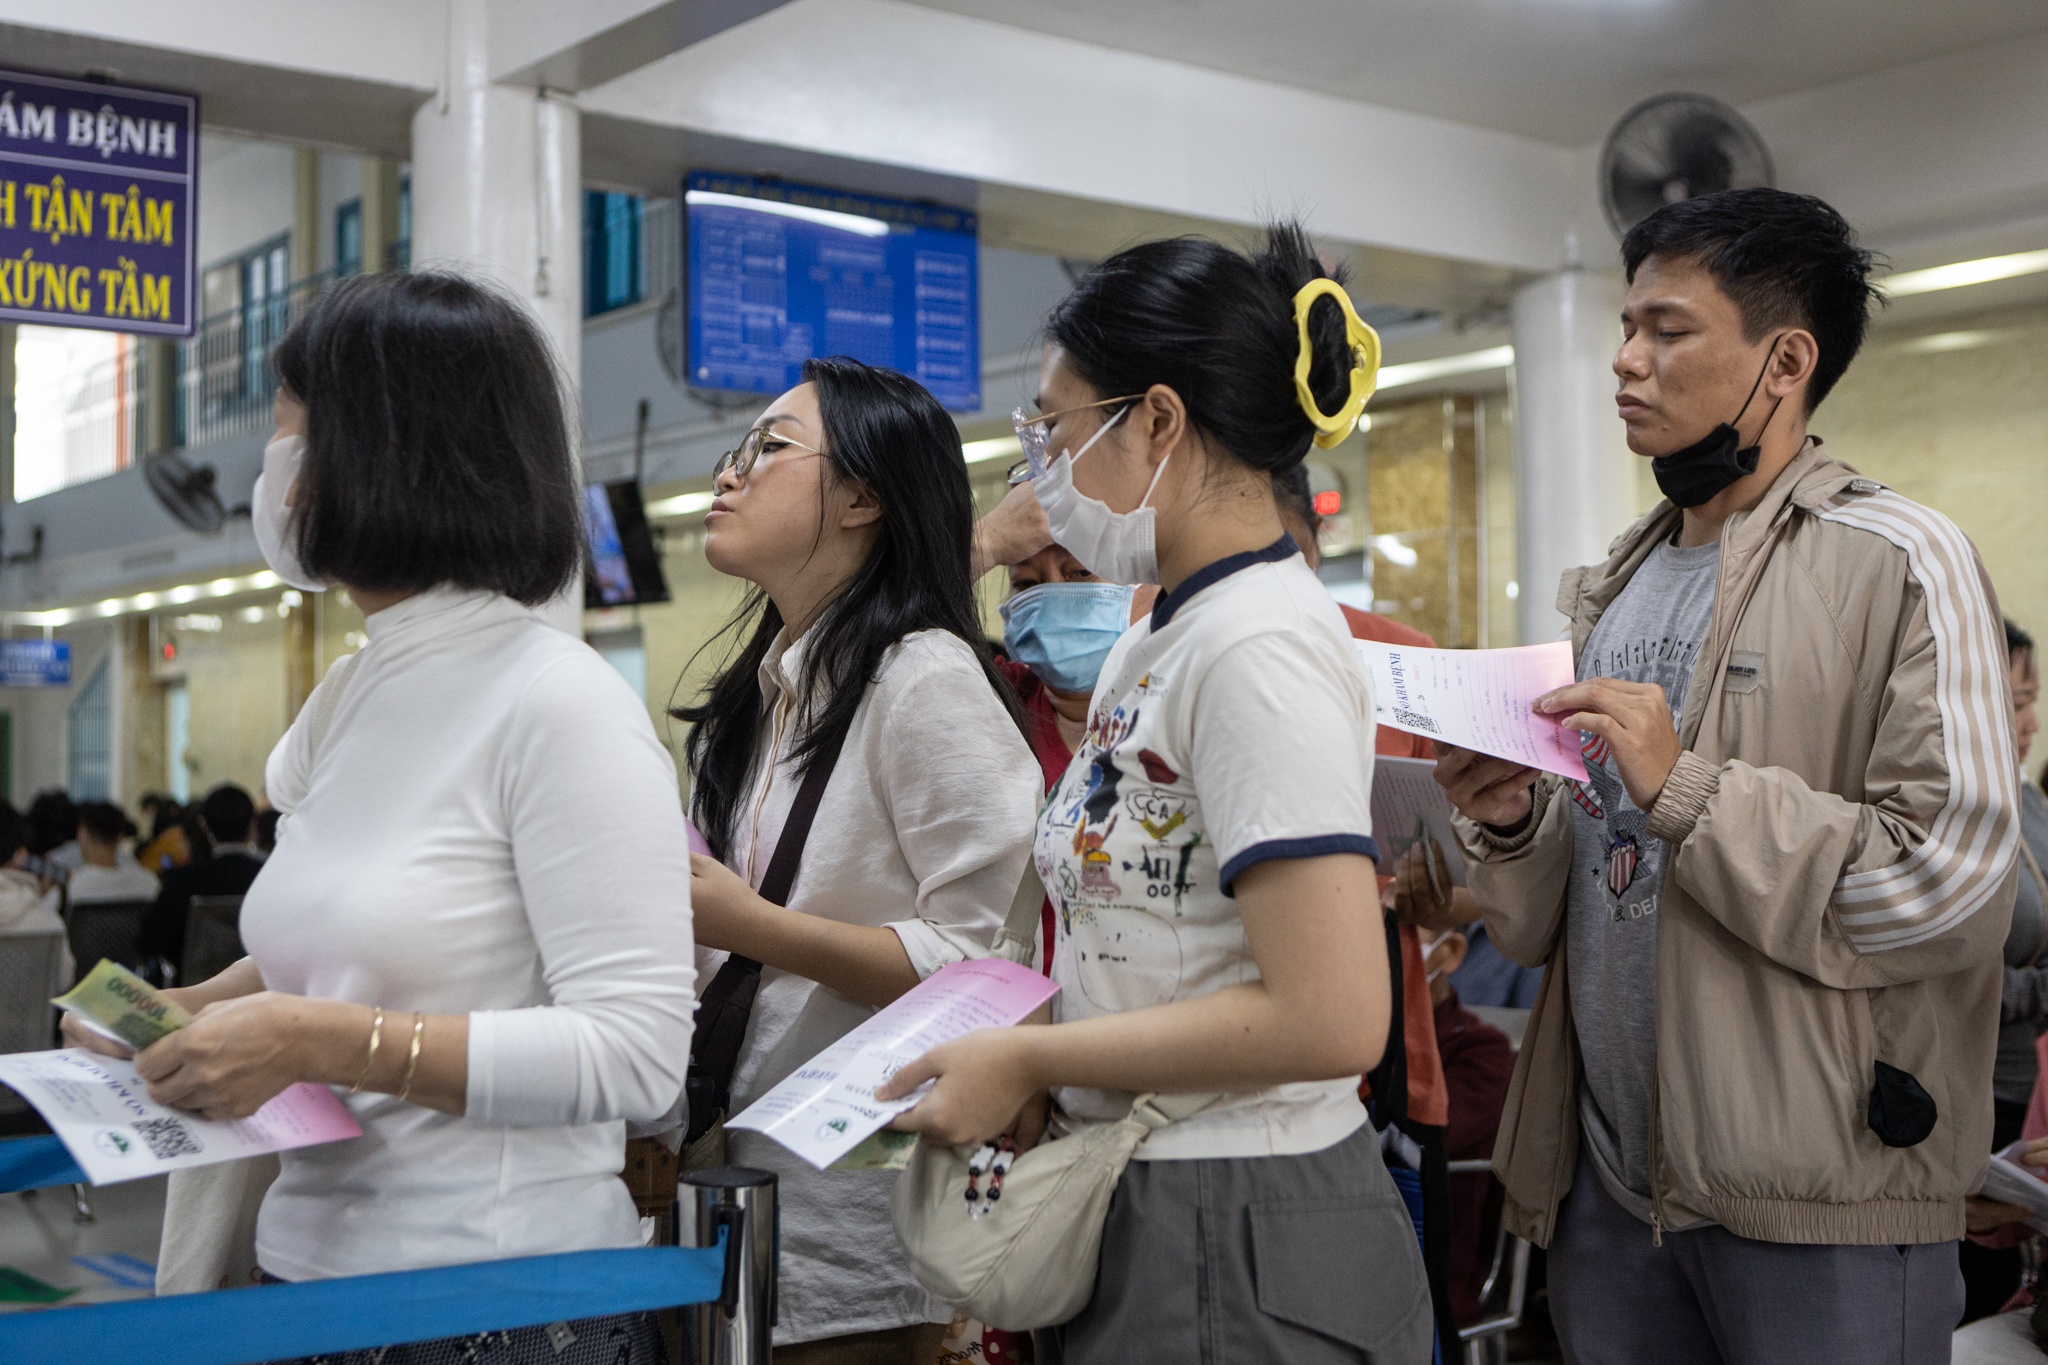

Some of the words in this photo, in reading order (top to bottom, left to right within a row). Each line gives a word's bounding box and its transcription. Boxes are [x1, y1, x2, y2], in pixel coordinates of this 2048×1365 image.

[66, 104, 176, 158] BỆNH
[24, 175, 94, 244] TẬN
[101, 184, 173, 246] TÂM
[99, 256, 171, 320] TẦM
